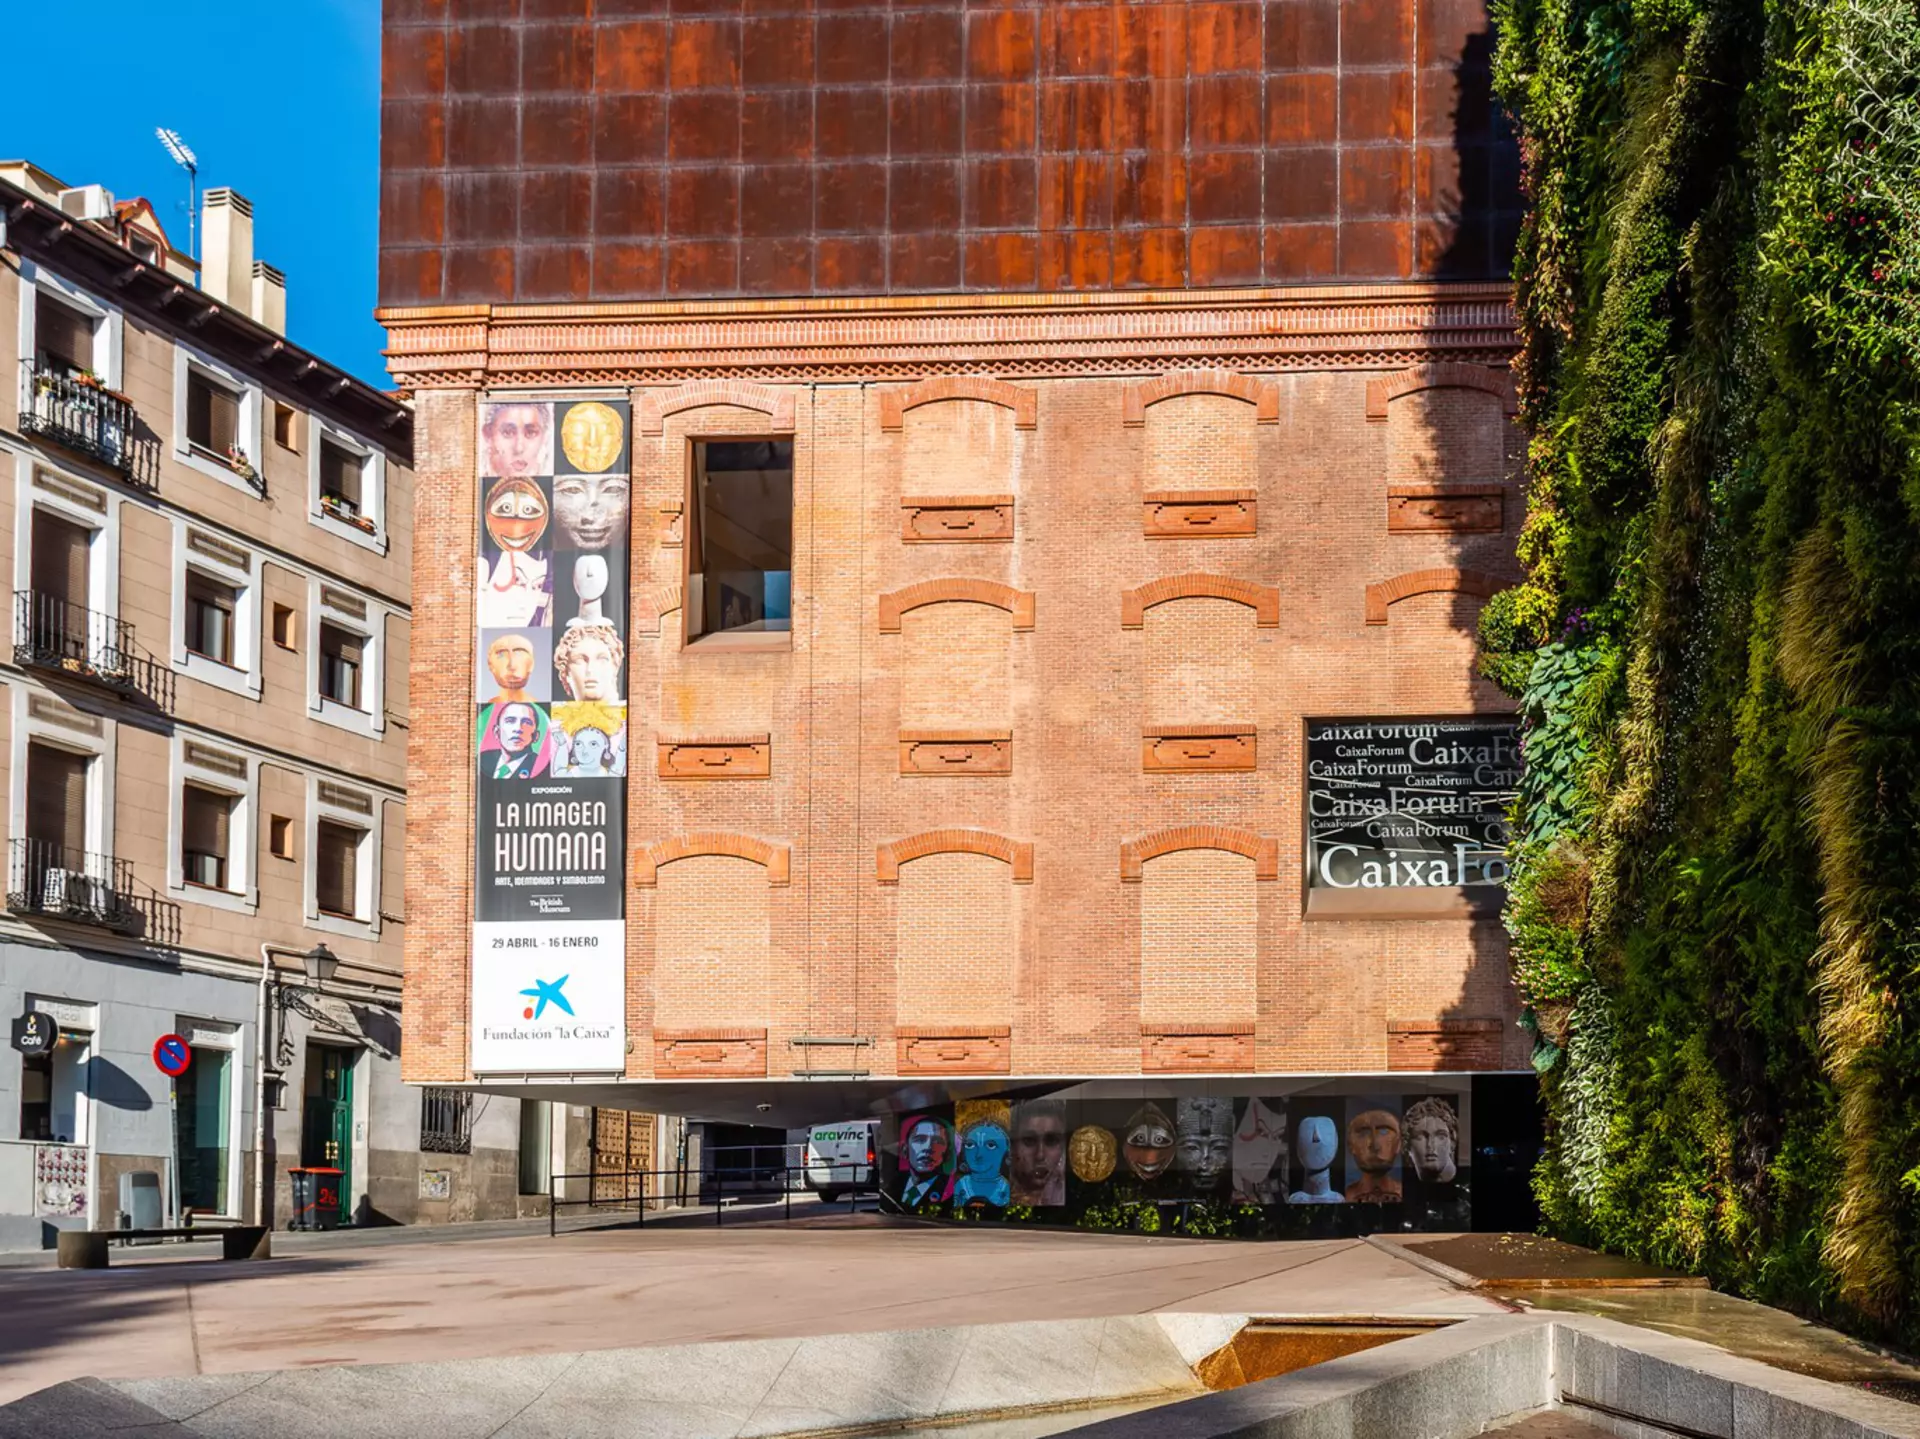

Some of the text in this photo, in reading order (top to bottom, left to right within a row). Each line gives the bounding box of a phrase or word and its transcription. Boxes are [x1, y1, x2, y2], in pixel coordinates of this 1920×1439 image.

[1308, 723, 1437, 741] aixaorum
[1335, 744, 1404, 757] CaixaForum
[1309, 760, 1412, 776] CaixaForum
[1405, 775, 1472, 787] CaixaForum
[531, 786, 572, 794] EXPOSICIÓN
[1309, 788, 1483, 817] CaixaForum
[495, 801, 606, 828] LA IMAGEN
[1367, 821, 1469, 839] CaixaForum
[494, 831, 606, 872] HUMANA
[1320, 842, 1512, 888] CaixaFo
[556, 876, 561, 885] Y
[540, 898, 563, 907] British
[540, 905, 571, 913] Museum
[492, 938, 504, 949] 29
[506, 938, 538, 948] ABRIL
[549, 937, 560, 948] 16
[563, 936, 599, 948] ENERO
[483, 1026, 615, 1040] Fundación "la Caixa"
[21, 1035, 42, 1046] Café
